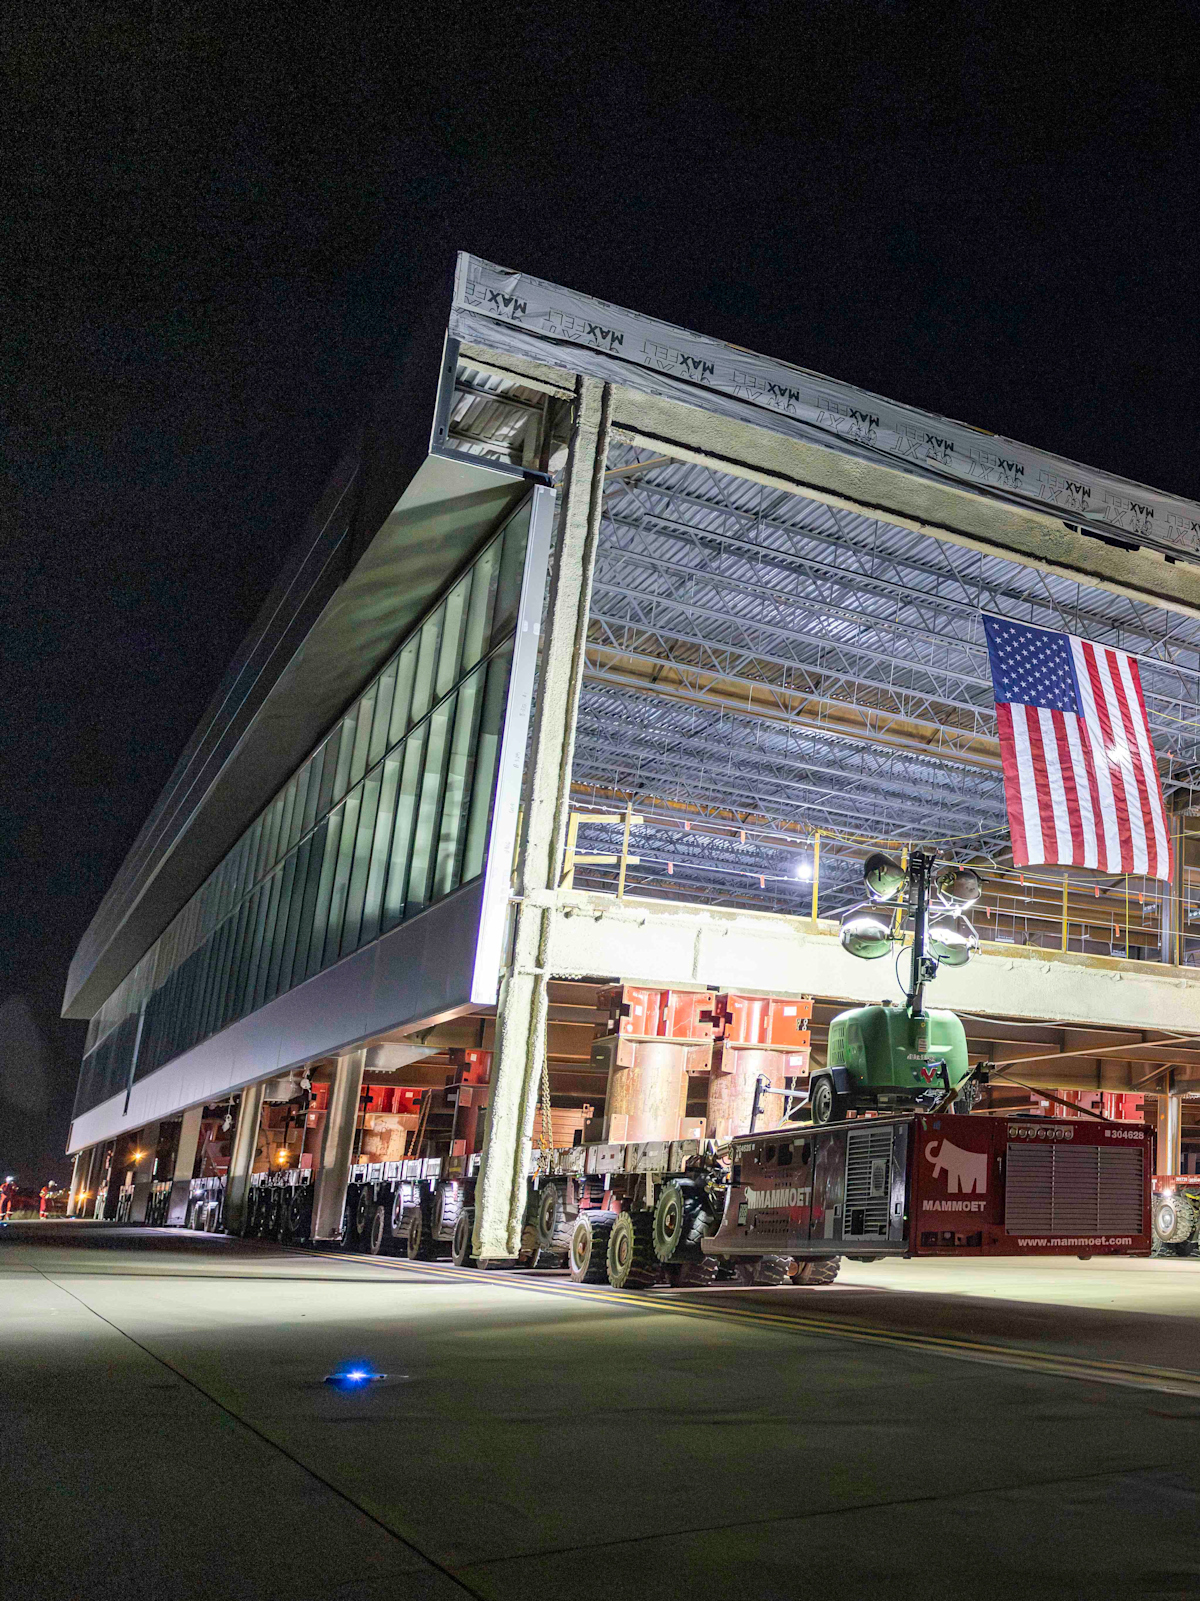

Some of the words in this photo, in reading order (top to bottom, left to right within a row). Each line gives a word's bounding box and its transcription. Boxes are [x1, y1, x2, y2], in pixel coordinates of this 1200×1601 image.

[755, 1187, 811, 1208] MAMMOET
[922, 1200, 986, 1212] MAMMOET
[1018, 1236, 1132, 1247] www.mammoet.com
